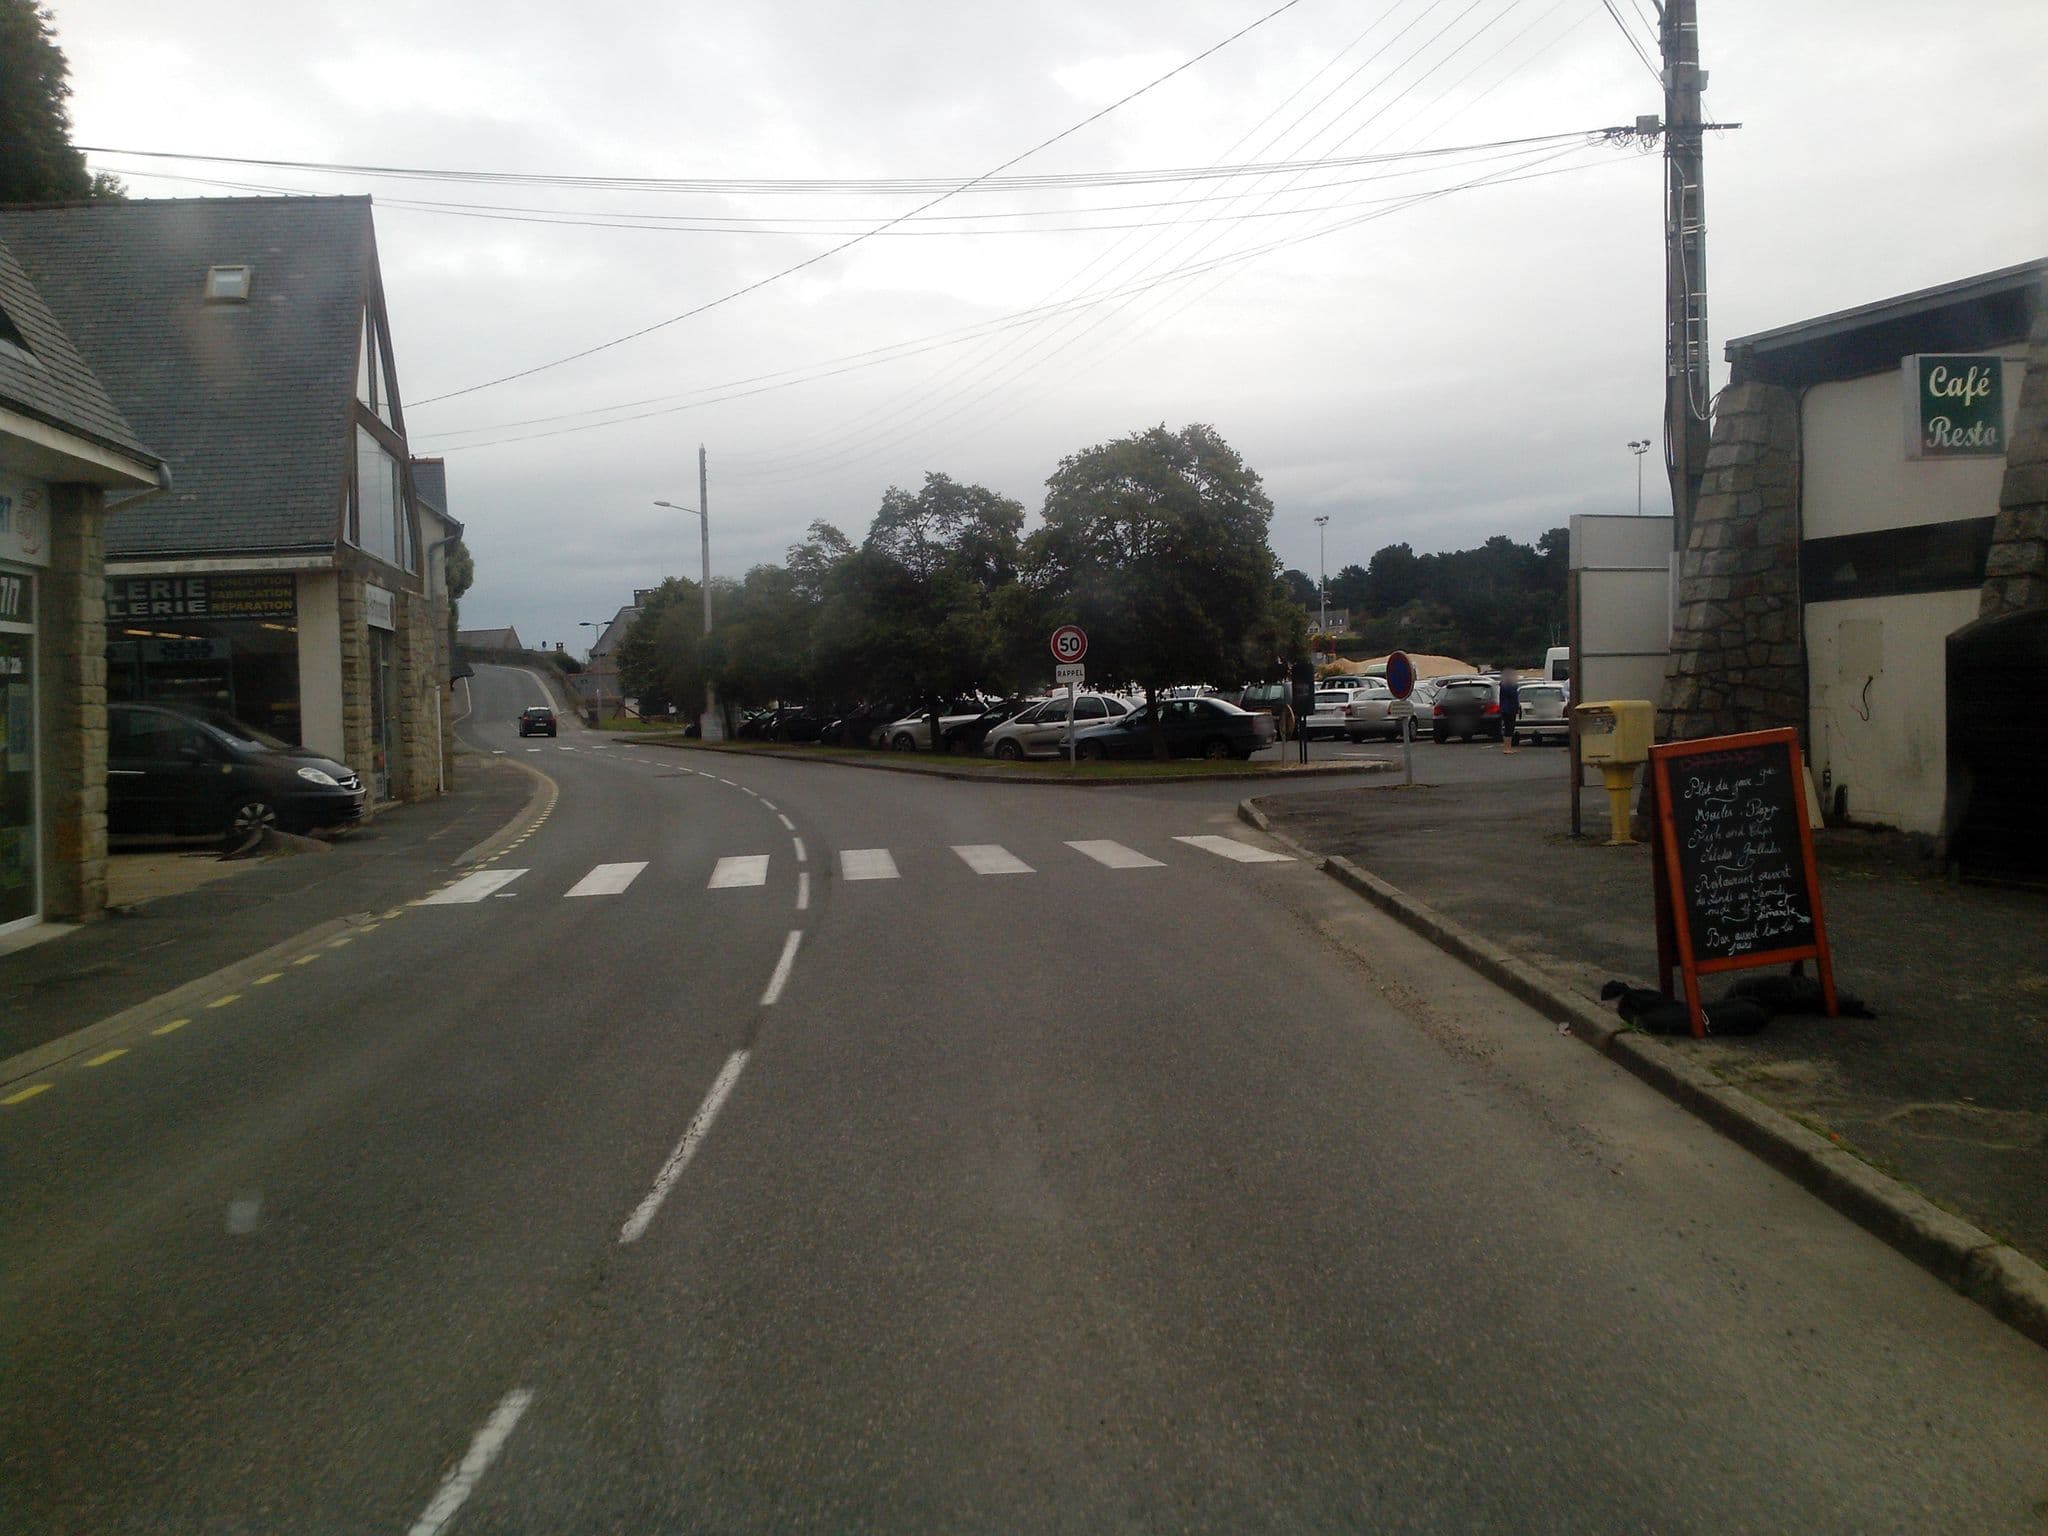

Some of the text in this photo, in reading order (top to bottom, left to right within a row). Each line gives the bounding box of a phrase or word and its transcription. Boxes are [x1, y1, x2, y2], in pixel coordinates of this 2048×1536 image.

[1929, 365, 1990, 407] Café
[1926, 416, 1999, 449] Resto
[1060, 637, 1080, 651] 50
[1684, 777, 1711, 798] Plat
[1715, 778, 1728, 791] du
[1695, 864, 1792, 893] Restaurant ouvert
[1706, 928, 1730, 947] Bar
